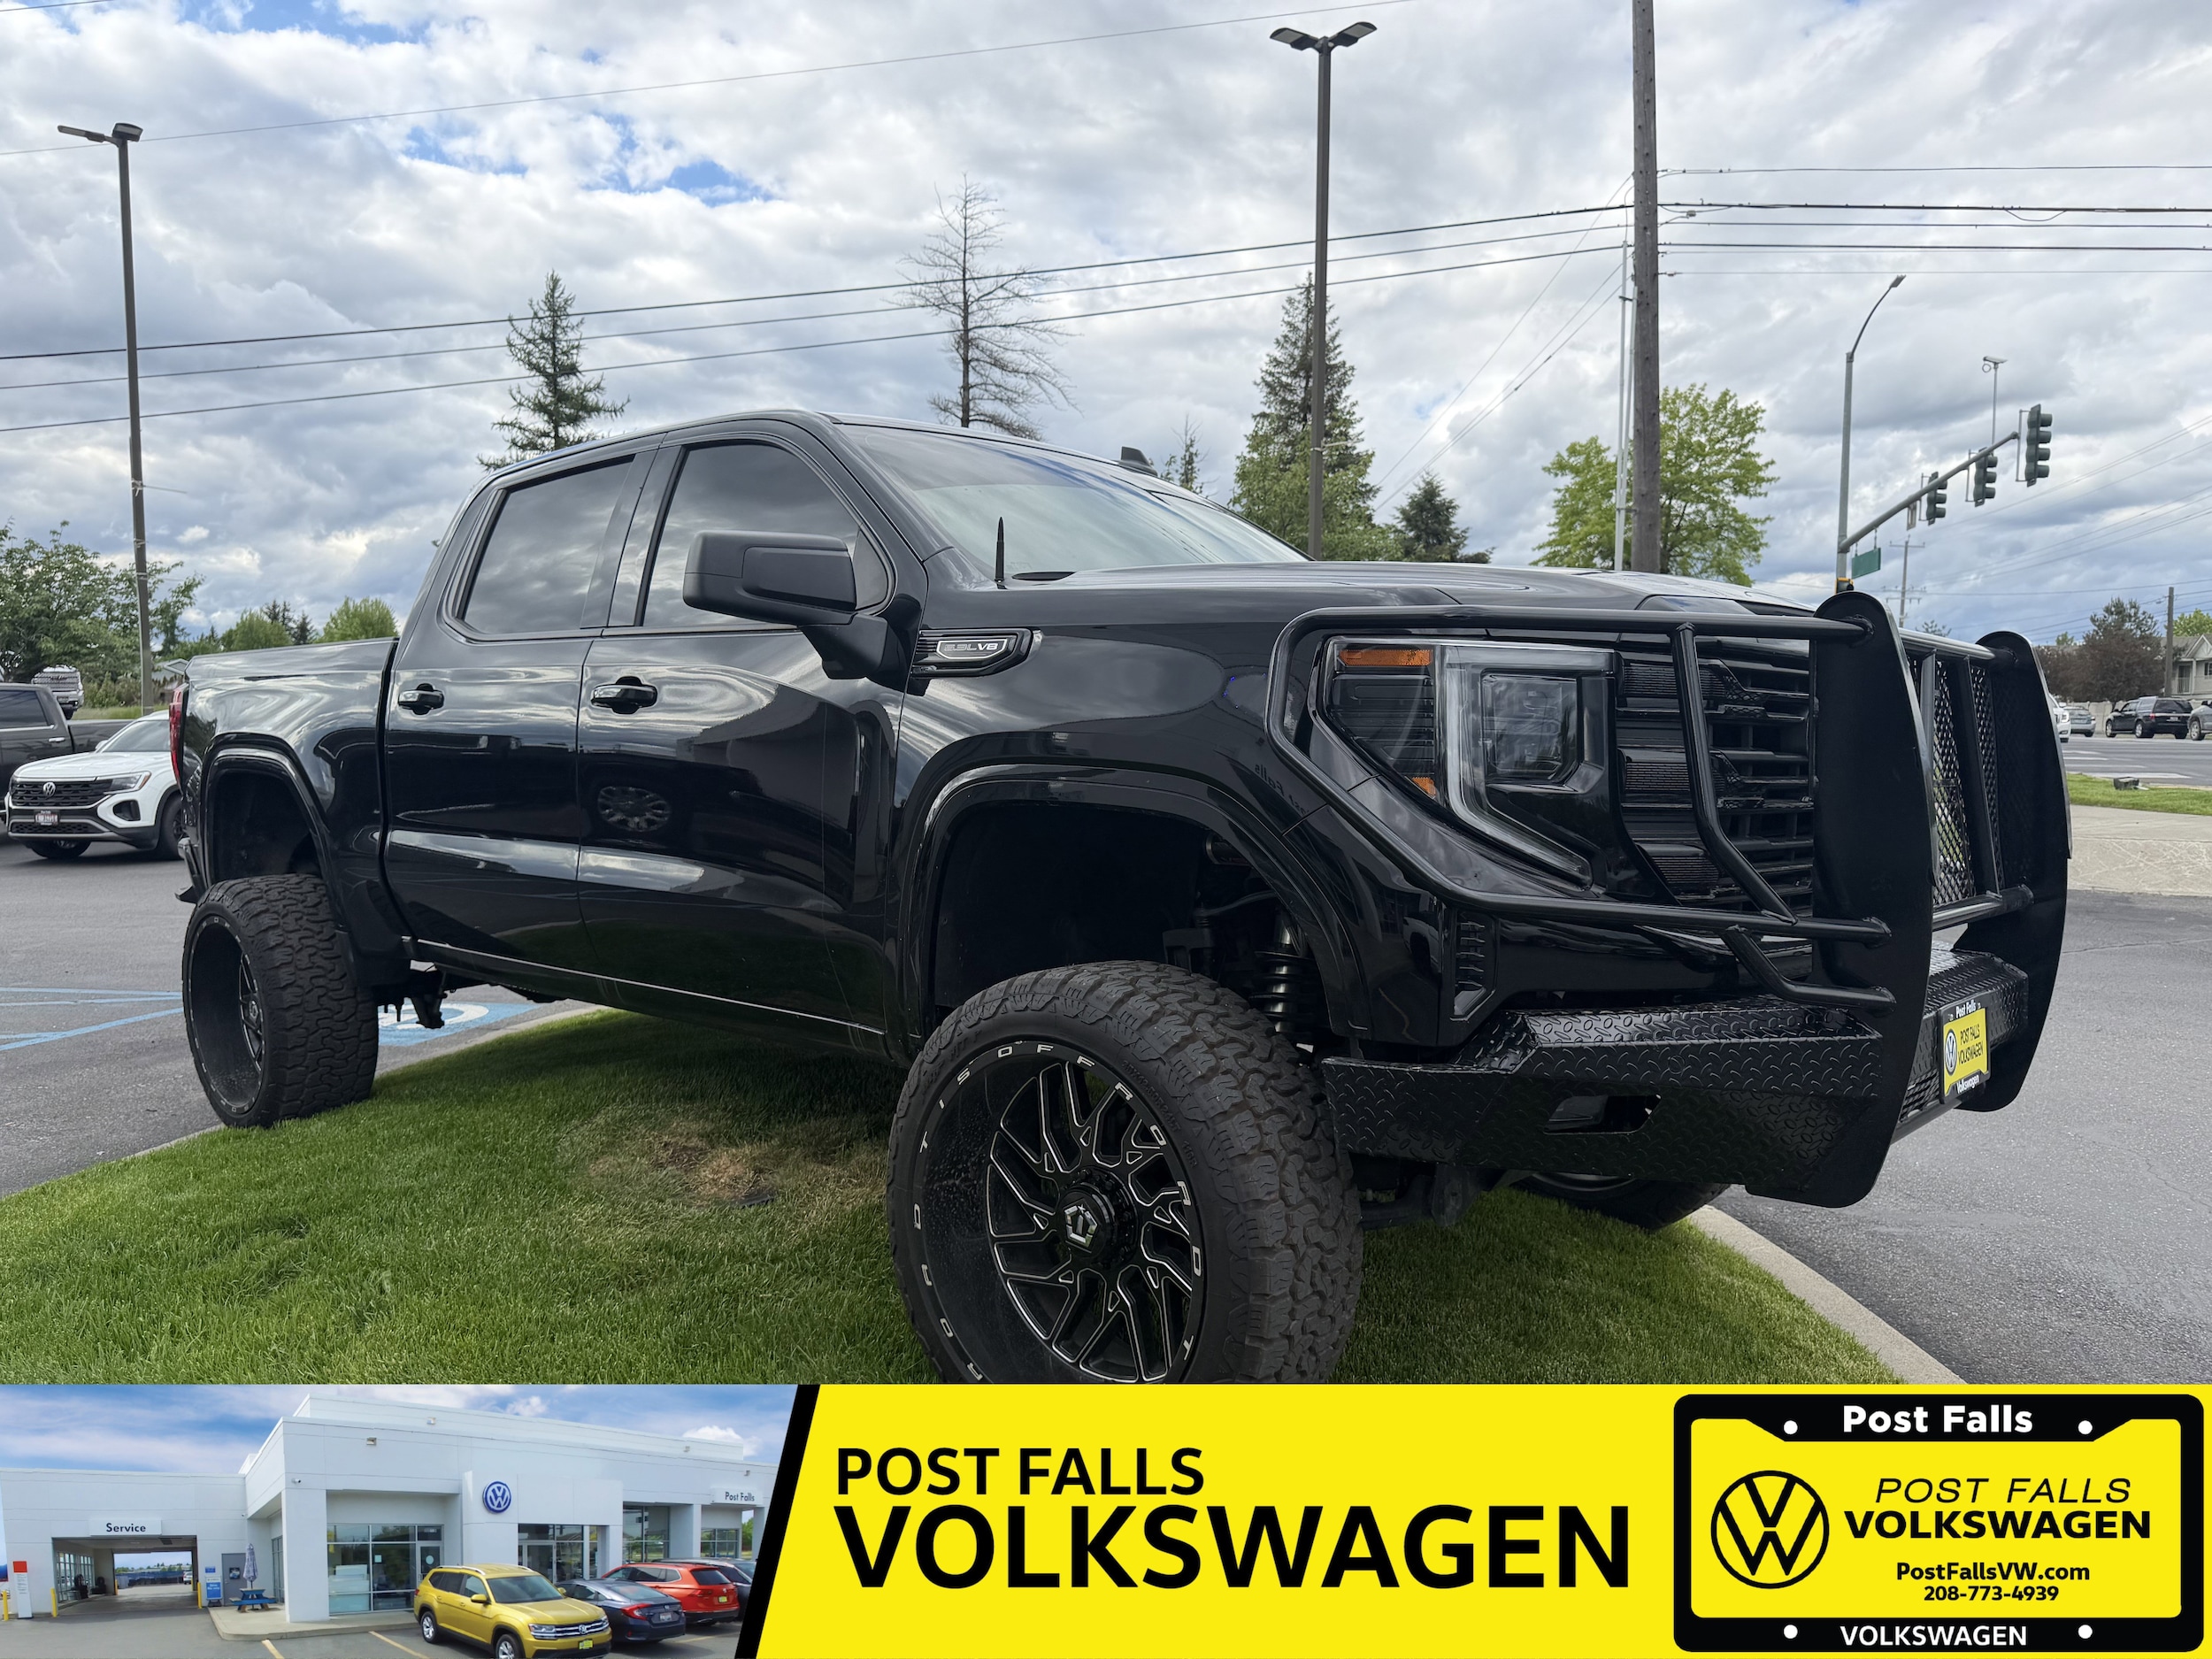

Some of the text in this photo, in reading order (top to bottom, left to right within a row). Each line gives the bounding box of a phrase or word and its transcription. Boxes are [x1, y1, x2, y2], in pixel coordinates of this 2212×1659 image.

[1955, 999, 1977, 1019] Post Falls
[1960, 1024, 1980, 1045] POST FALLS
[1958, 1042, 1984, 1065] VOLKSWAGEN
[1956, 1074, 1979, 1094] Volkswagen
[725, 1491, 756, 1502] Post Falls
[105, 1522, 146, 1532] Service
